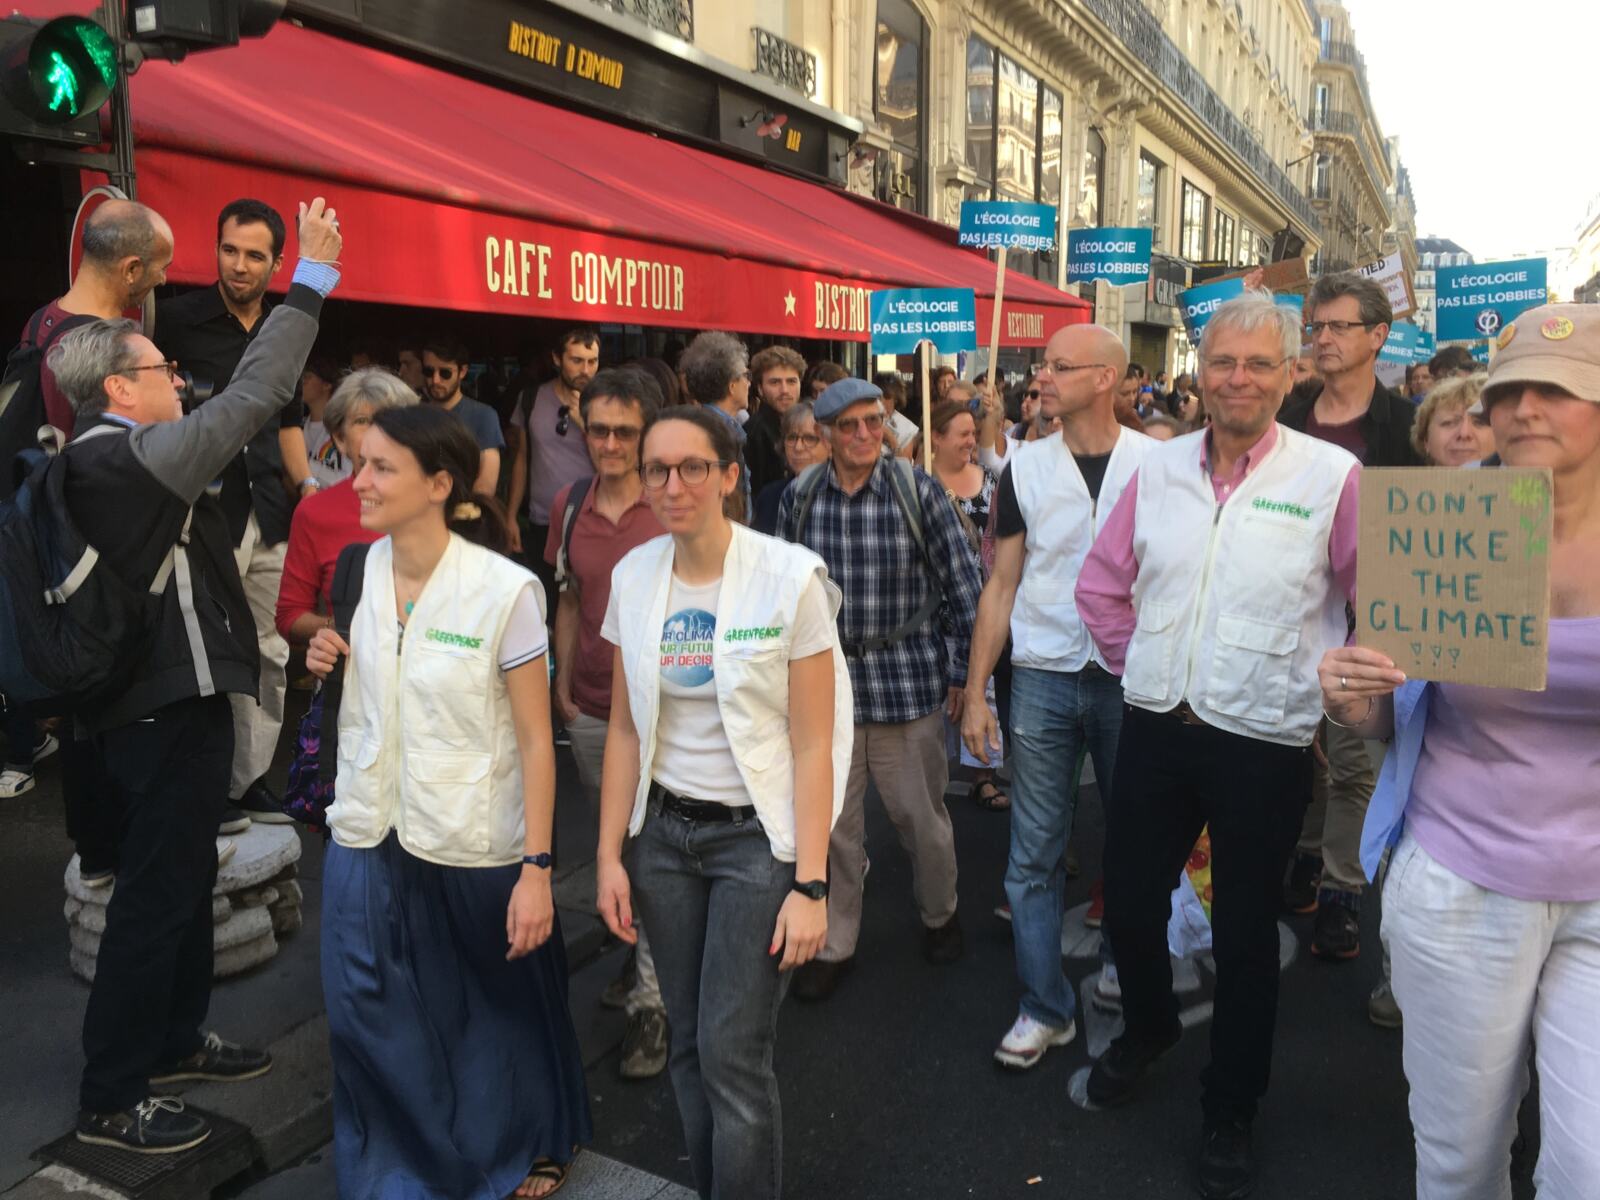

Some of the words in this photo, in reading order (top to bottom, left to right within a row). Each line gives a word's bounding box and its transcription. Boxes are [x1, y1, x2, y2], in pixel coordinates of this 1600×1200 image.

[508, 21, 561, 67] BISTROT
[974, 211, 1041, 227] L'ÉCOLOGIE
[960, 233, 980, 244] PAS
[982, 233, 1001, 245] LES
[1004, 234, 1053, 248] LOBBIES
[1075, 240, 1137, 254] L'ÉCOLOGIE
[485, 236, 552, 299] CAFE
[570, 250, 684, 311] COMPTOIR
[1067, 264, 1079, 274] PAS
[1080, 263, 1095, 274] LES
[1098, 262, 1149, 274] LOBBIES
[1451, 271, 1528, 288] L'ÉCOLOGIE
[889, 299, 959, 314] L'ÉCOLOGIE
[1437, 296, 1460, 308] PAS
[1463, 294, 1486, 306] LES
[1488, 288, 1546, 304] LOBBIES
[815, 281, 872, 333] BISTROT
[873, 323, 898, 334] PAS
[900, 322, 923, 333] LES
[925, 320, 975, 333] LOBBIES
[1007, 311, 1044, 338] RESTAURANT
[1387, 483, 1498, 517] DON'T
[1388, 527, 1509, 562] NUKE
[1412, 568, 1483, 603] THE
[1369, 600, 1540, 647] CLIMATE
[676, 630, 714, 642] CLIMA
[723, 627, 783, 643] GREENPEACE
[660, 655, 674, 666] UR
[678, 654, 713, 666] DECIS
